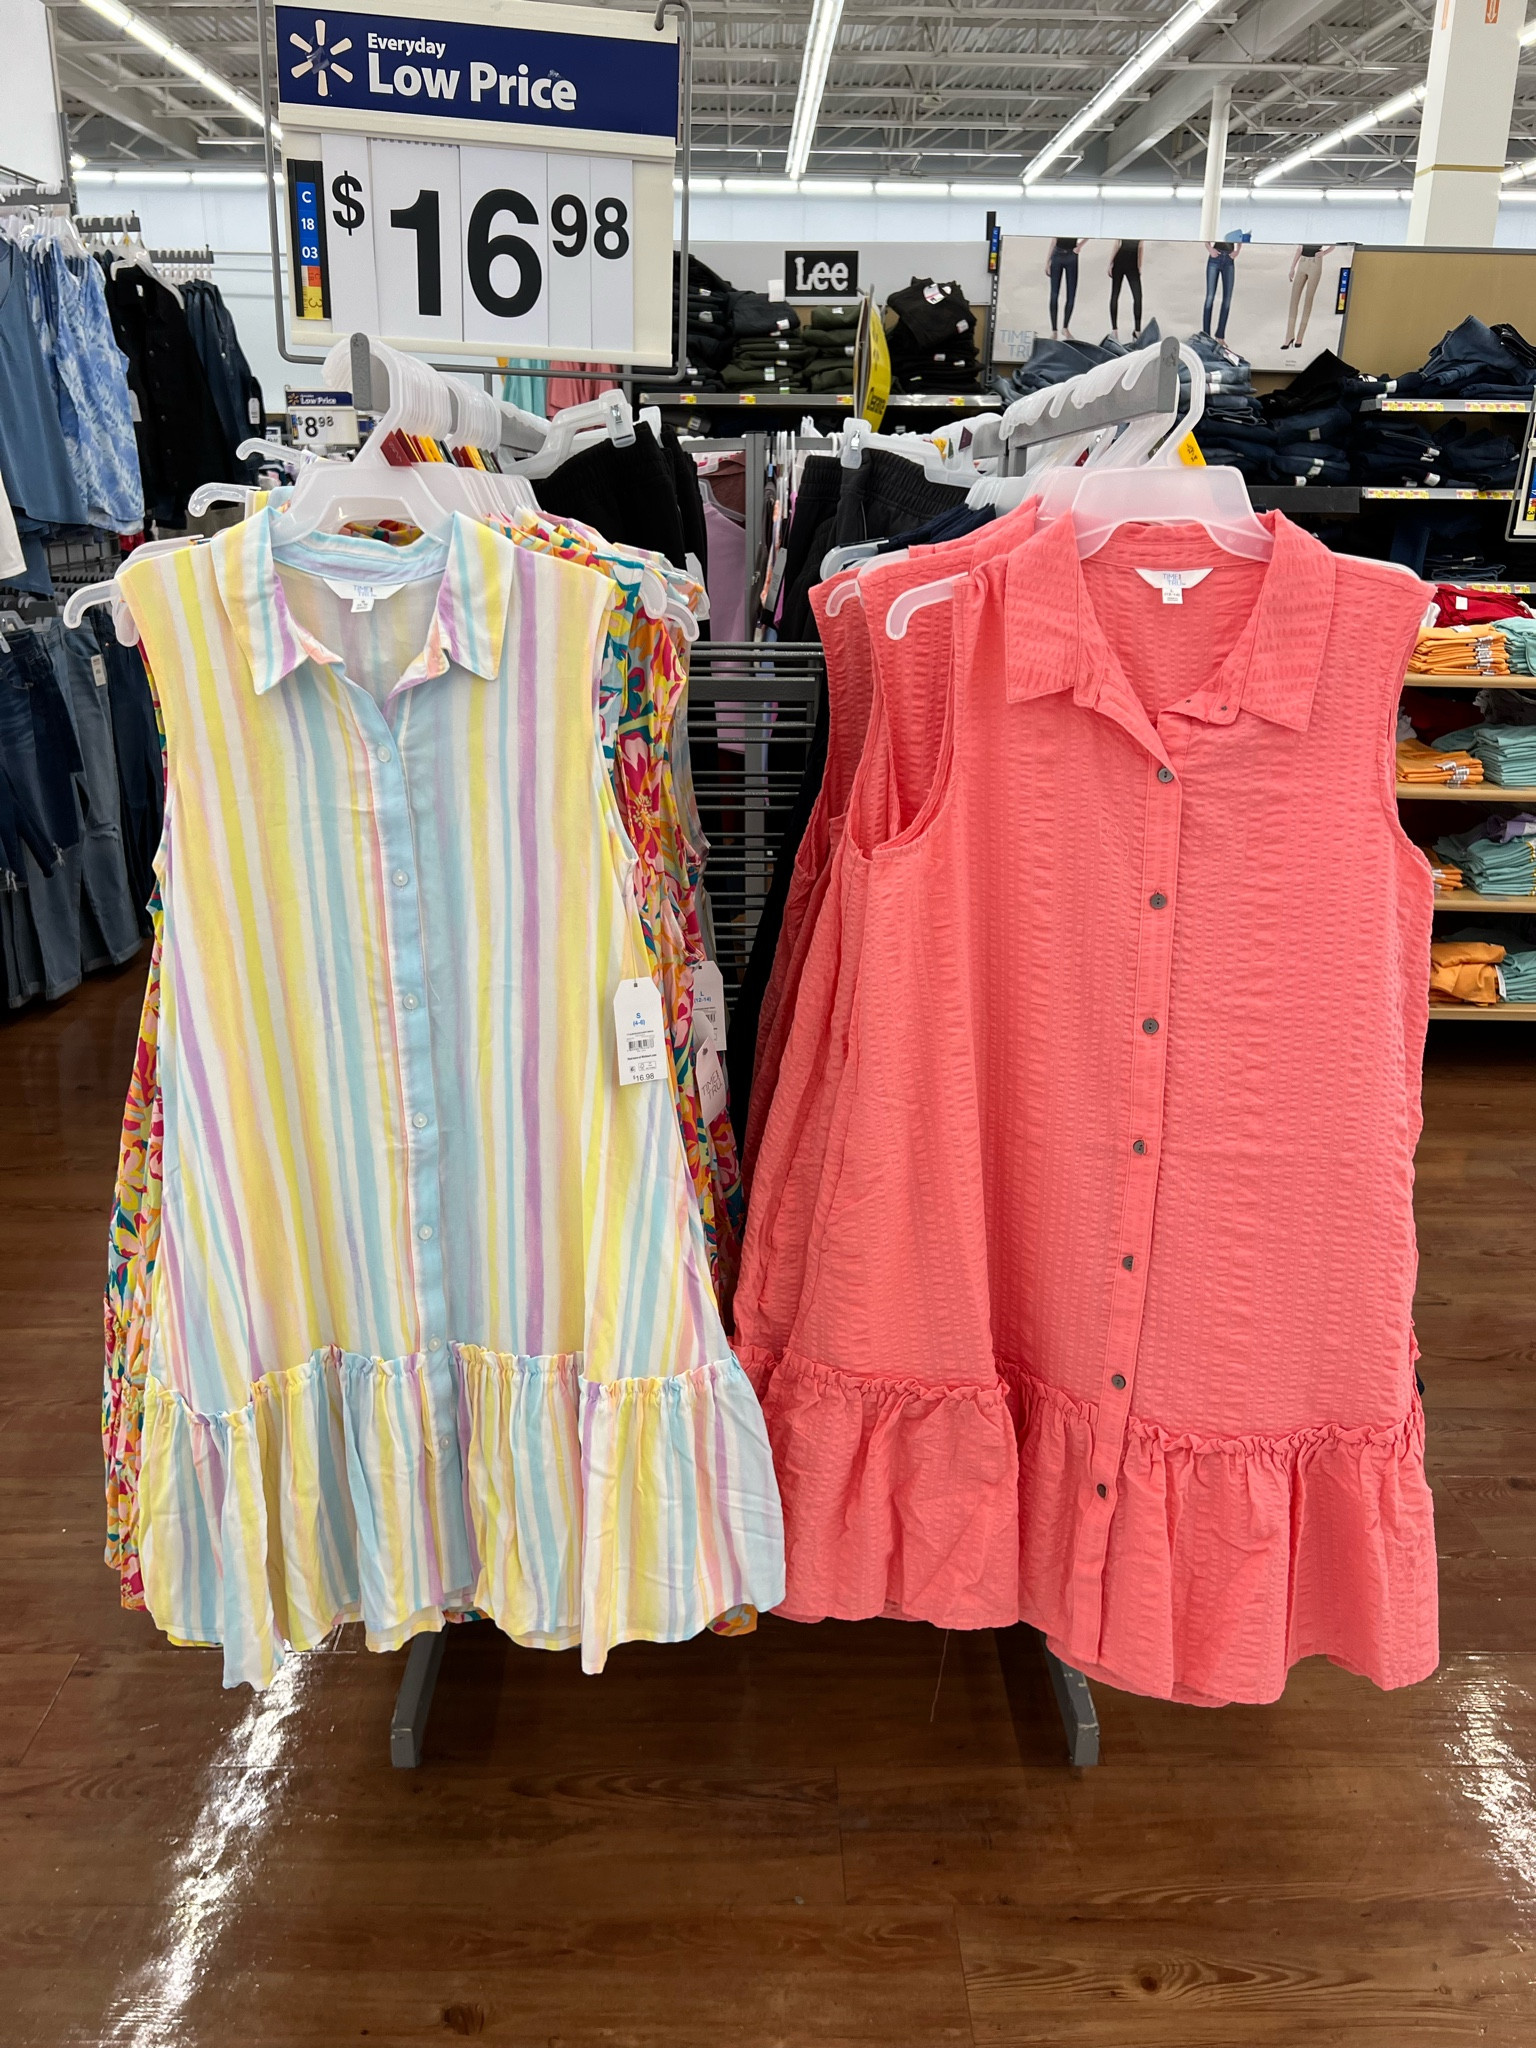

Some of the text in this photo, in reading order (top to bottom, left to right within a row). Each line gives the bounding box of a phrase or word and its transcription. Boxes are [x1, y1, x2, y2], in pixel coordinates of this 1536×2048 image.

[367, 32, 446, 59] Everyday
[368, 52, 578, 111] Low Price
[301, 190, 312, 203] C
[331, 170, 365, 236] $
[301, 217, 315, 231] 18
[301, 246, 319, 259] 03
[794, 256, 849, 292] Lee
[999, 329, 1032, 344] TIME
[317, 396, 336, 404] Price
[305, 416, 318, 437] 8
[318, 416, 334, 427] 98
[633, 1073, 654, 1081] $16.98
